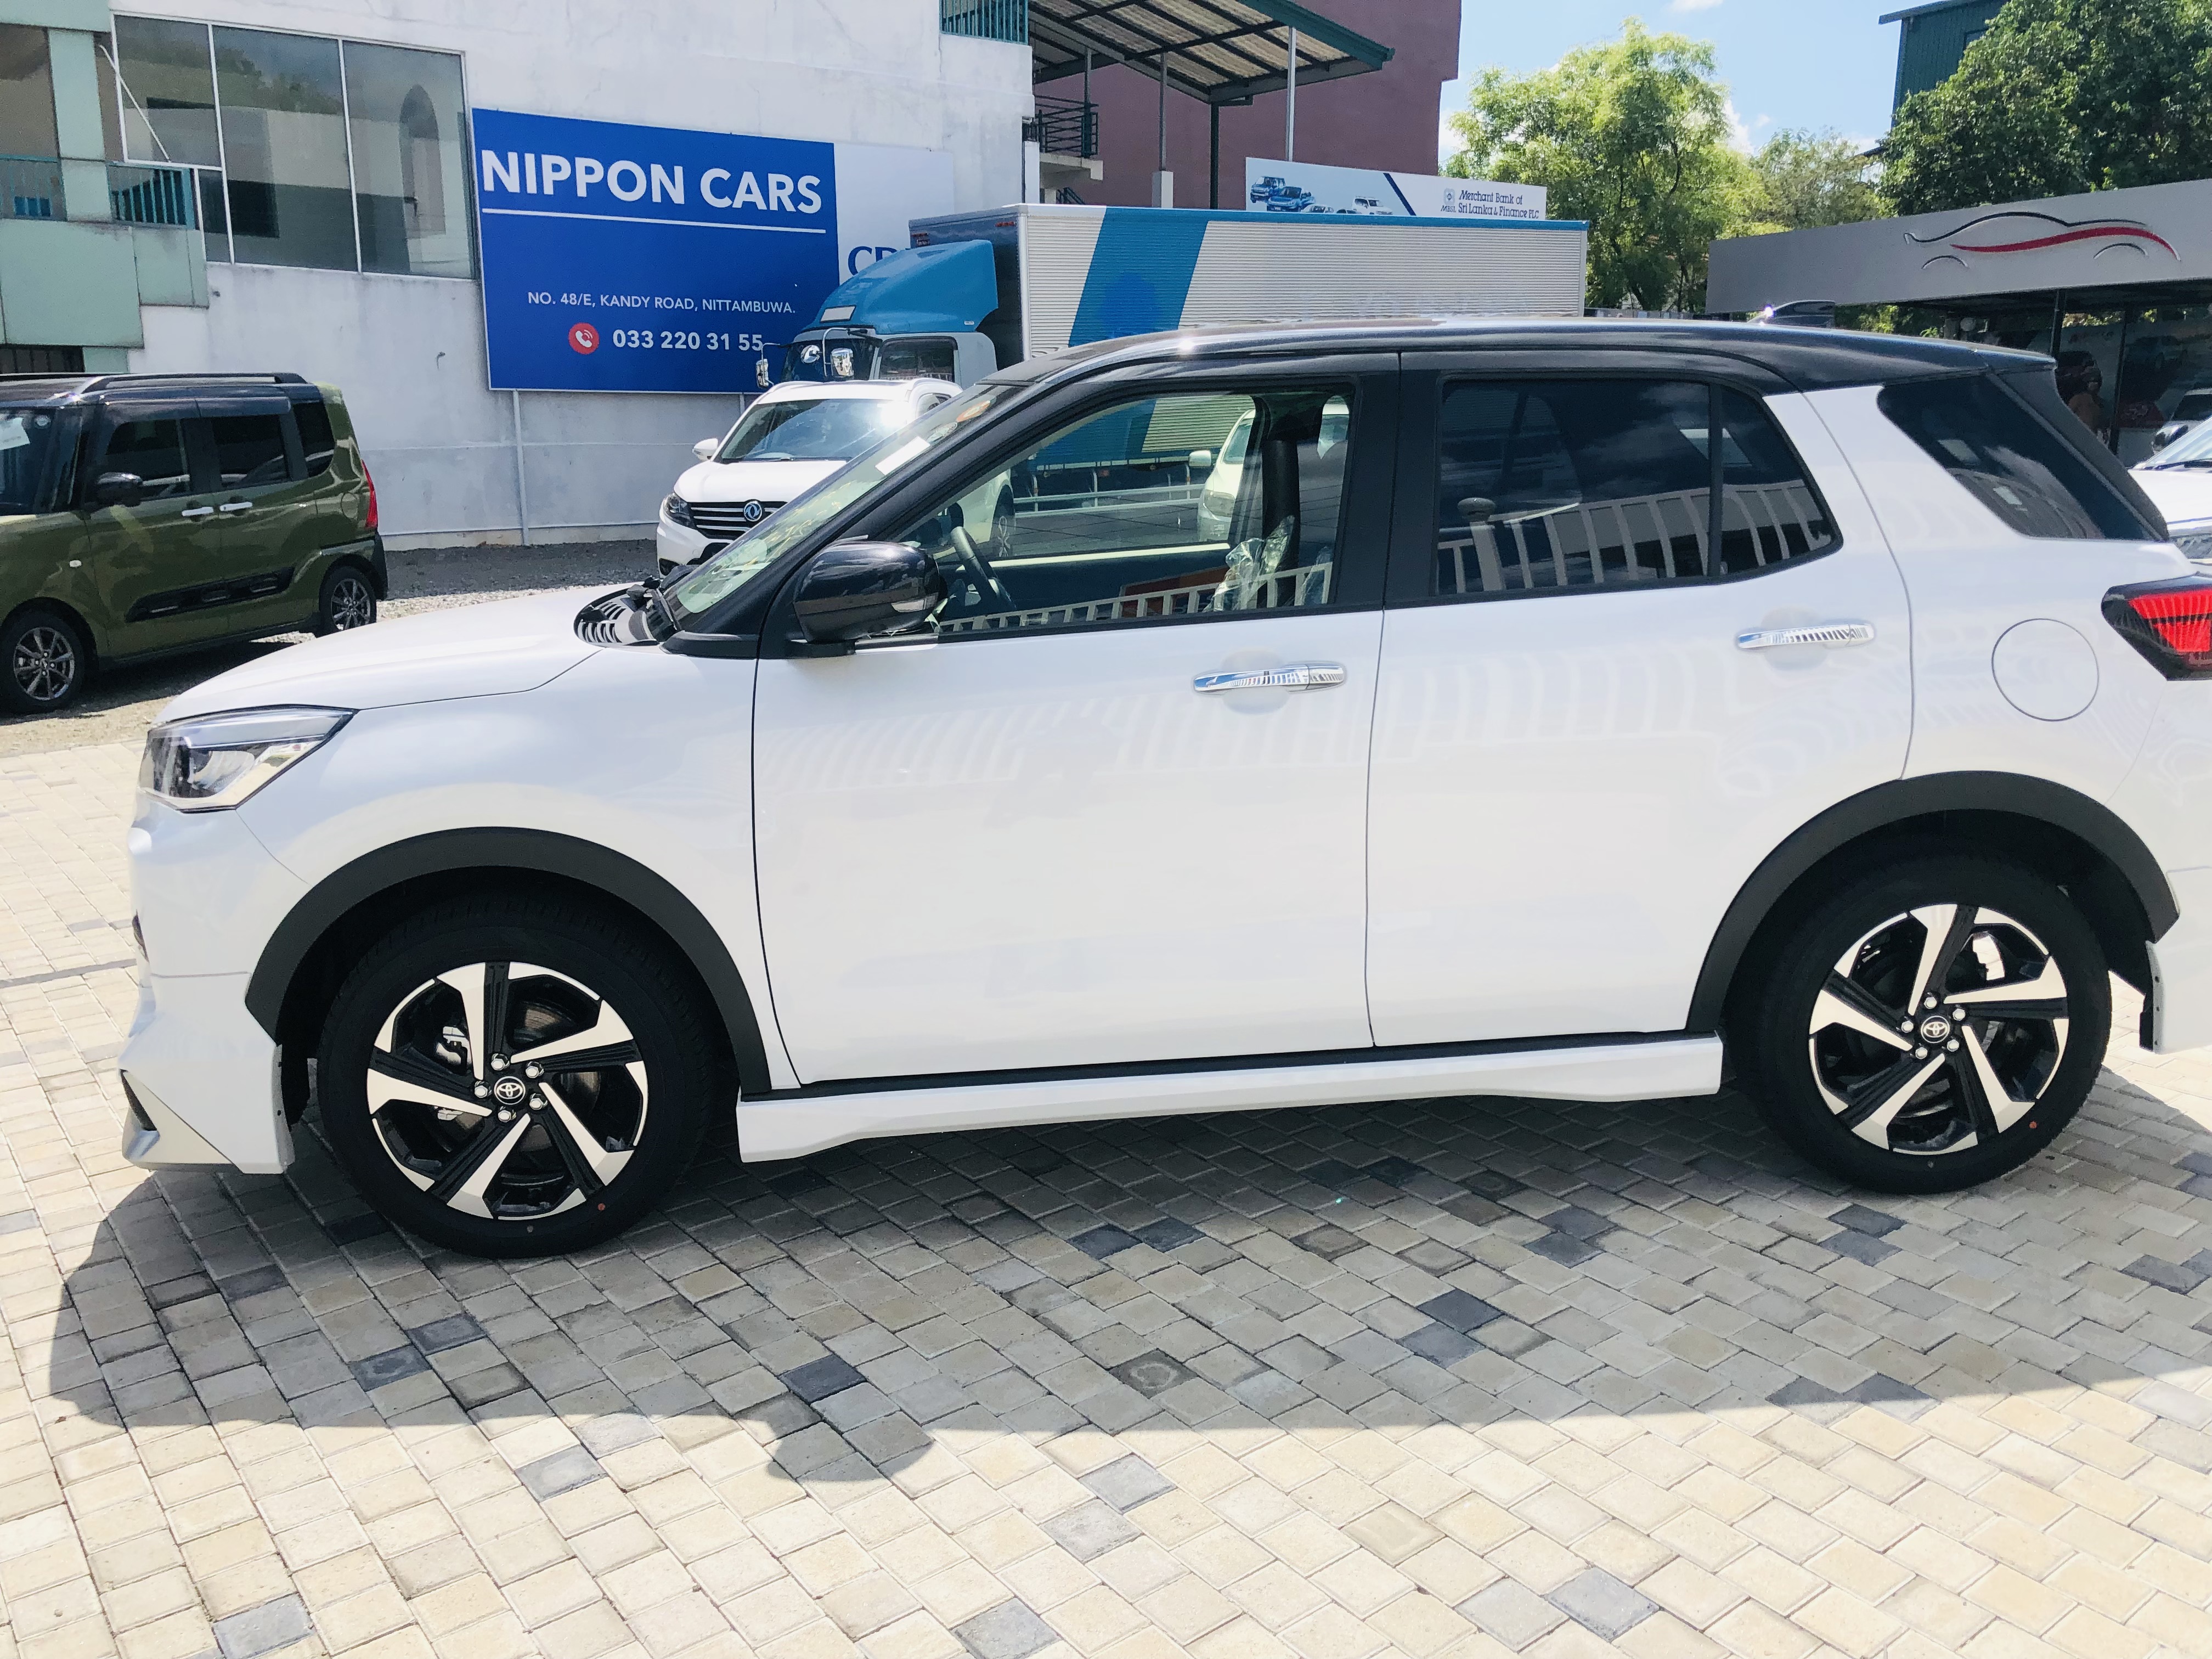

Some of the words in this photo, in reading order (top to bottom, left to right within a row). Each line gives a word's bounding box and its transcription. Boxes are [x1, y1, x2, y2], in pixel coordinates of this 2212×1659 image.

[481, 149, 685, 205] NIPPON
[700, 168, 822, 214] CARS
[1458, 190, 1494, 202] Merchant
[1496, 193, 1514, 204] Bank
[1516, 194, 1523, 205] of
[1440, 205, 1457, 213] MBSL
[1458, 202, 1468, 214] Sri
[1468, 203, 1493, 216] Lanka
[1493, 207, 1498, 216] &
[1499, 206, 1527, 218] Finance
[1528, 209, 1539, 219] PLC
[528, 291, 556, 304] NO.
[560, 293, 596, 308] 48/E,
[600, 294, 651, 308] KANDY
[654, 297, 698, 312] ROAD,
[702, 298, 795, 313] NITTAMBUWA.
[612, 329, 654, 348] 033
[660, 331, 701, 349] 220
[706, 332, 729, 350] 31
[738, 334, 763, 351] 55
